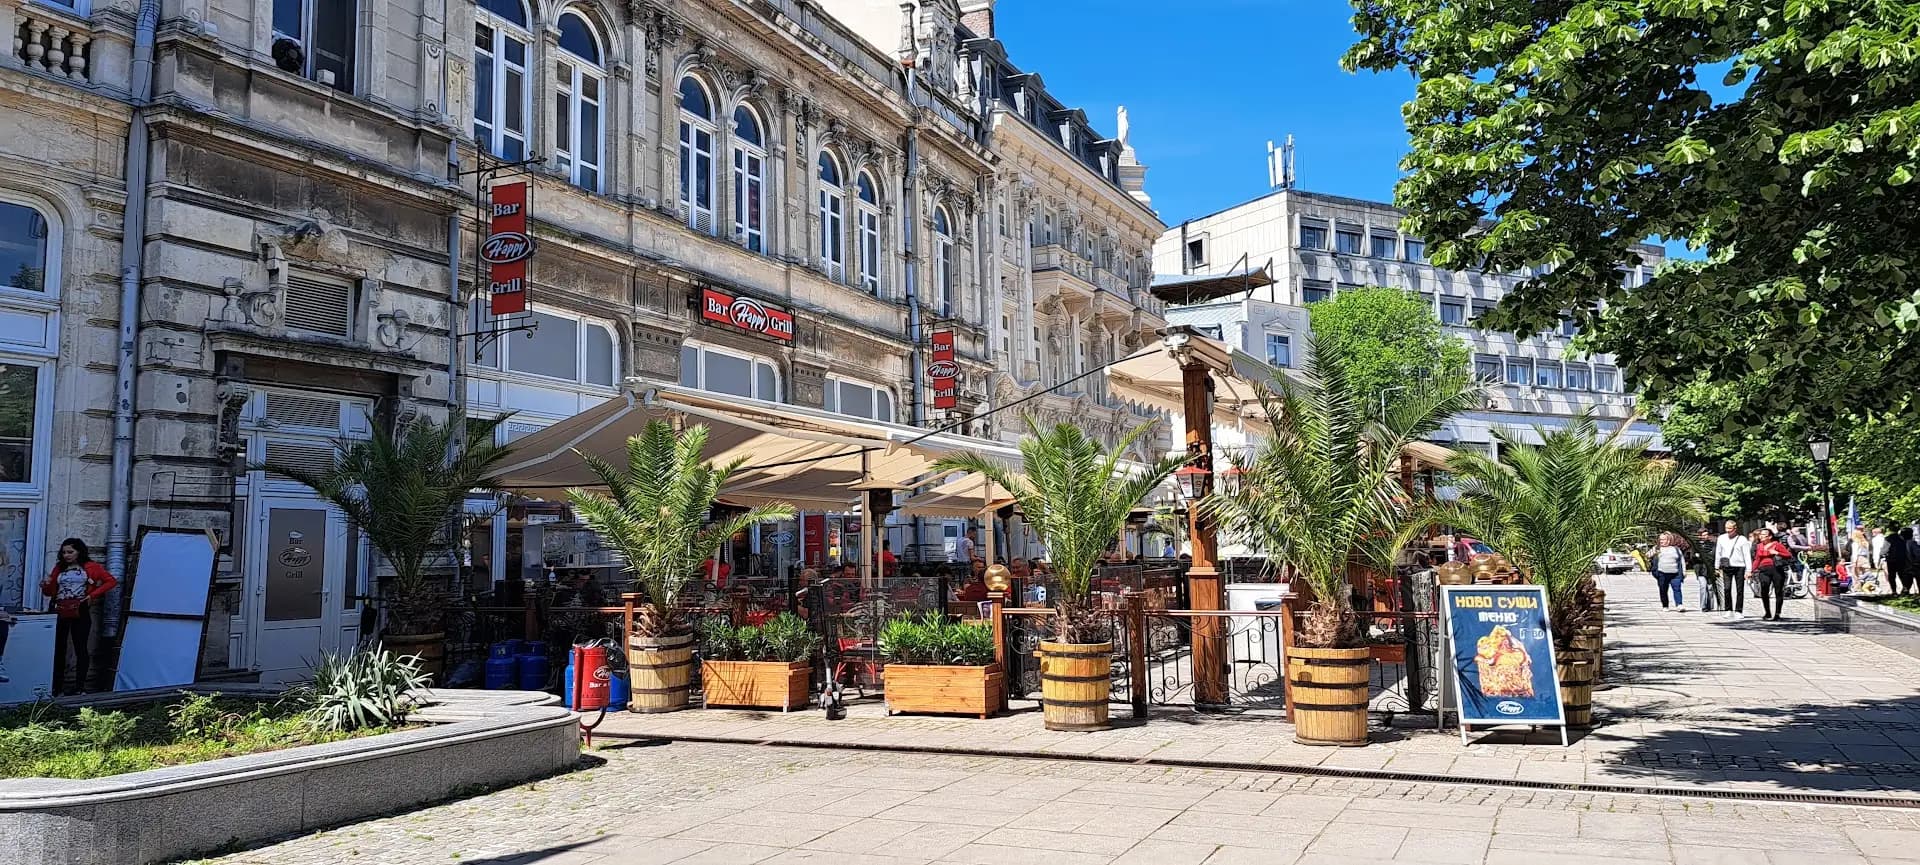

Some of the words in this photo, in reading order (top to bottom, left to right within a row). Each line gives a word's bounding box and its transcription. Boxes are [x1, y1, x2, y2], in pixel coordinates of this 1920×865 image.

[493, 202, 520, 217] Bar
[486, 239, 526, 258] Happy
[489, 278, 523, 295] Grill
[707, 297, 728, 317] Bar
[735, 303, 766, 330] Happy
[771, 316, 793, 334] Grill
[933, 343, 951, 352] Bar
[929, 363, 956, 377] Happy
[934, 388, 954, 398] Grill
[1455, 596, 1492, 608] НОВО
[1498, 596, 1538, 609] СУШИ
[1478, 611, 1519, 622] МЕНЮ
